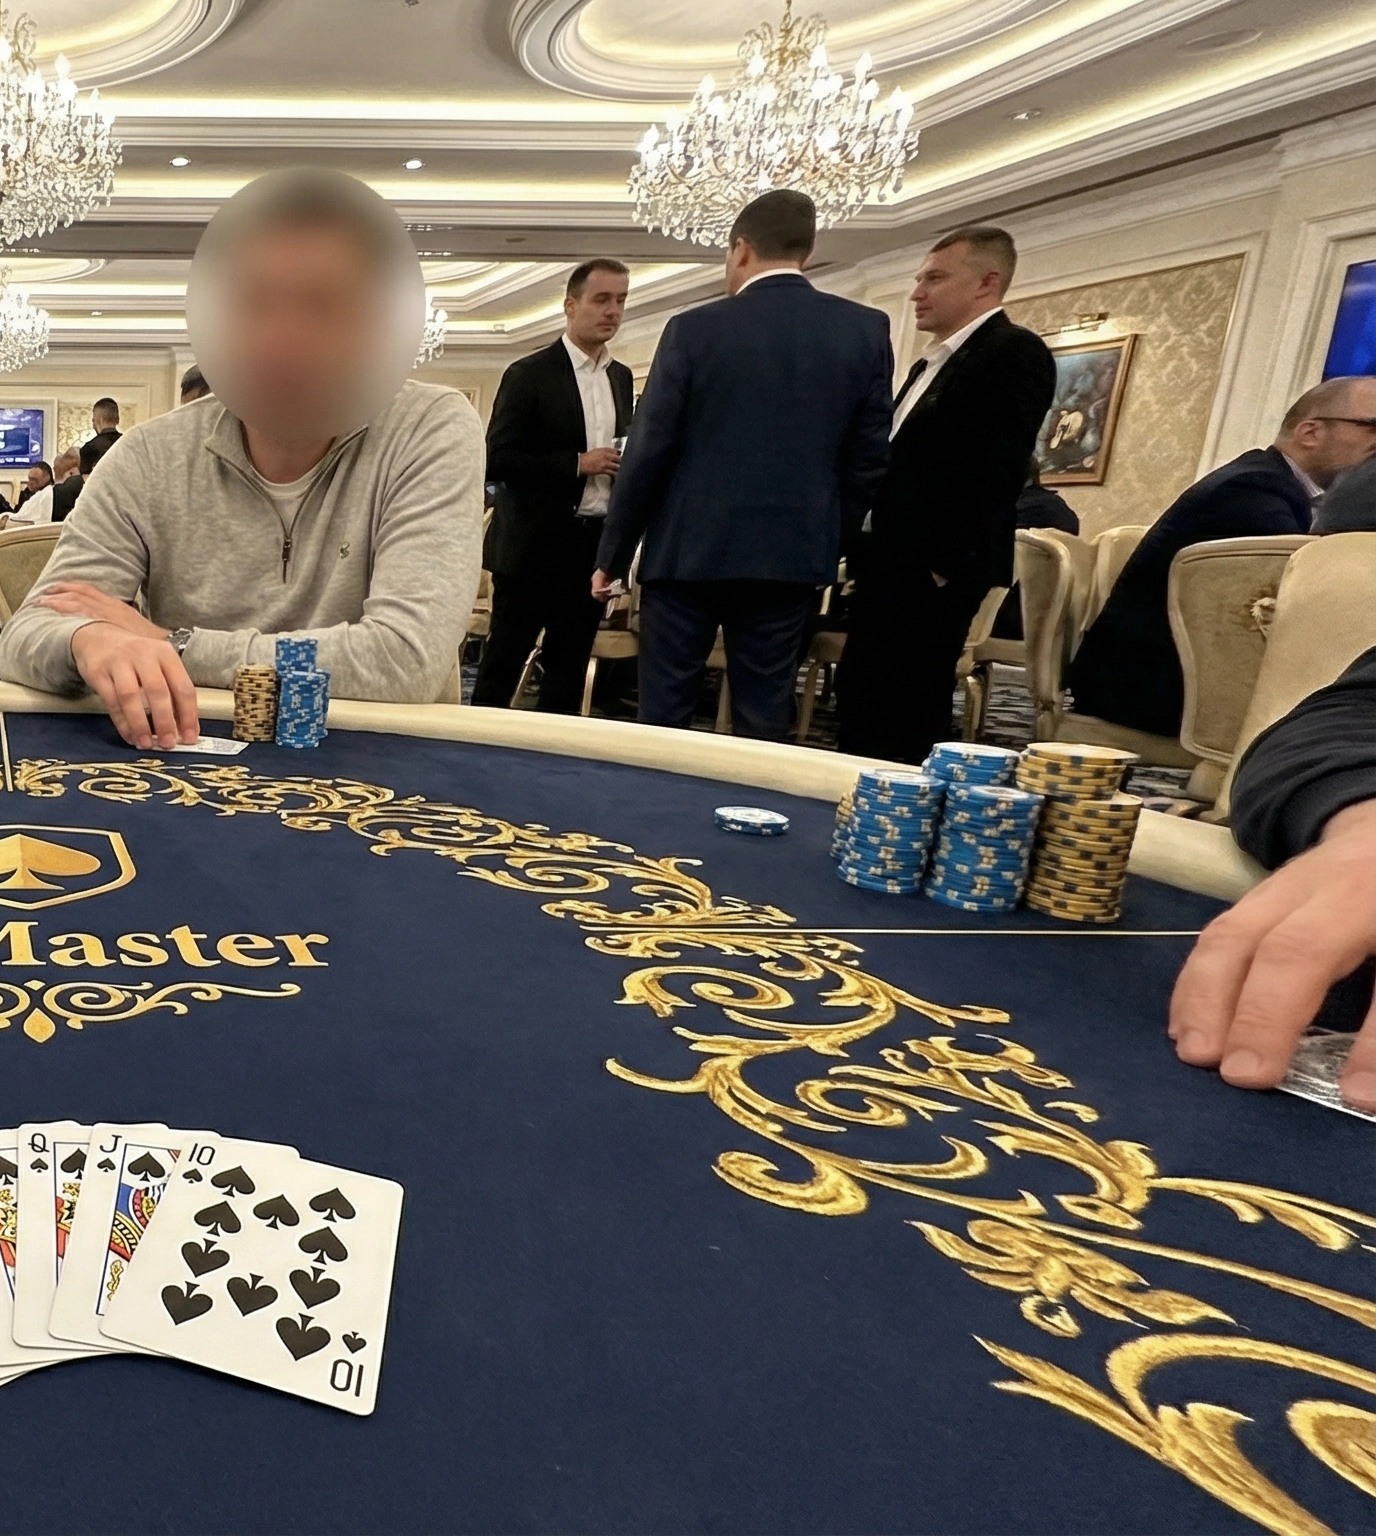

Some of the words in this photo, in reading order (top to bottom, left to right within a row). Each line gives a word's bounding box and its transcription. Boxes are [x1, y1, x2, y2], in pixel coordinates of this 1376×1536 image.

[28, 1133, 50, 1153] Q
[99, 1134, 122, 1153] J
[188, 1143, 216, 1166] 10
[330, 1359, 364, 1397] 10
